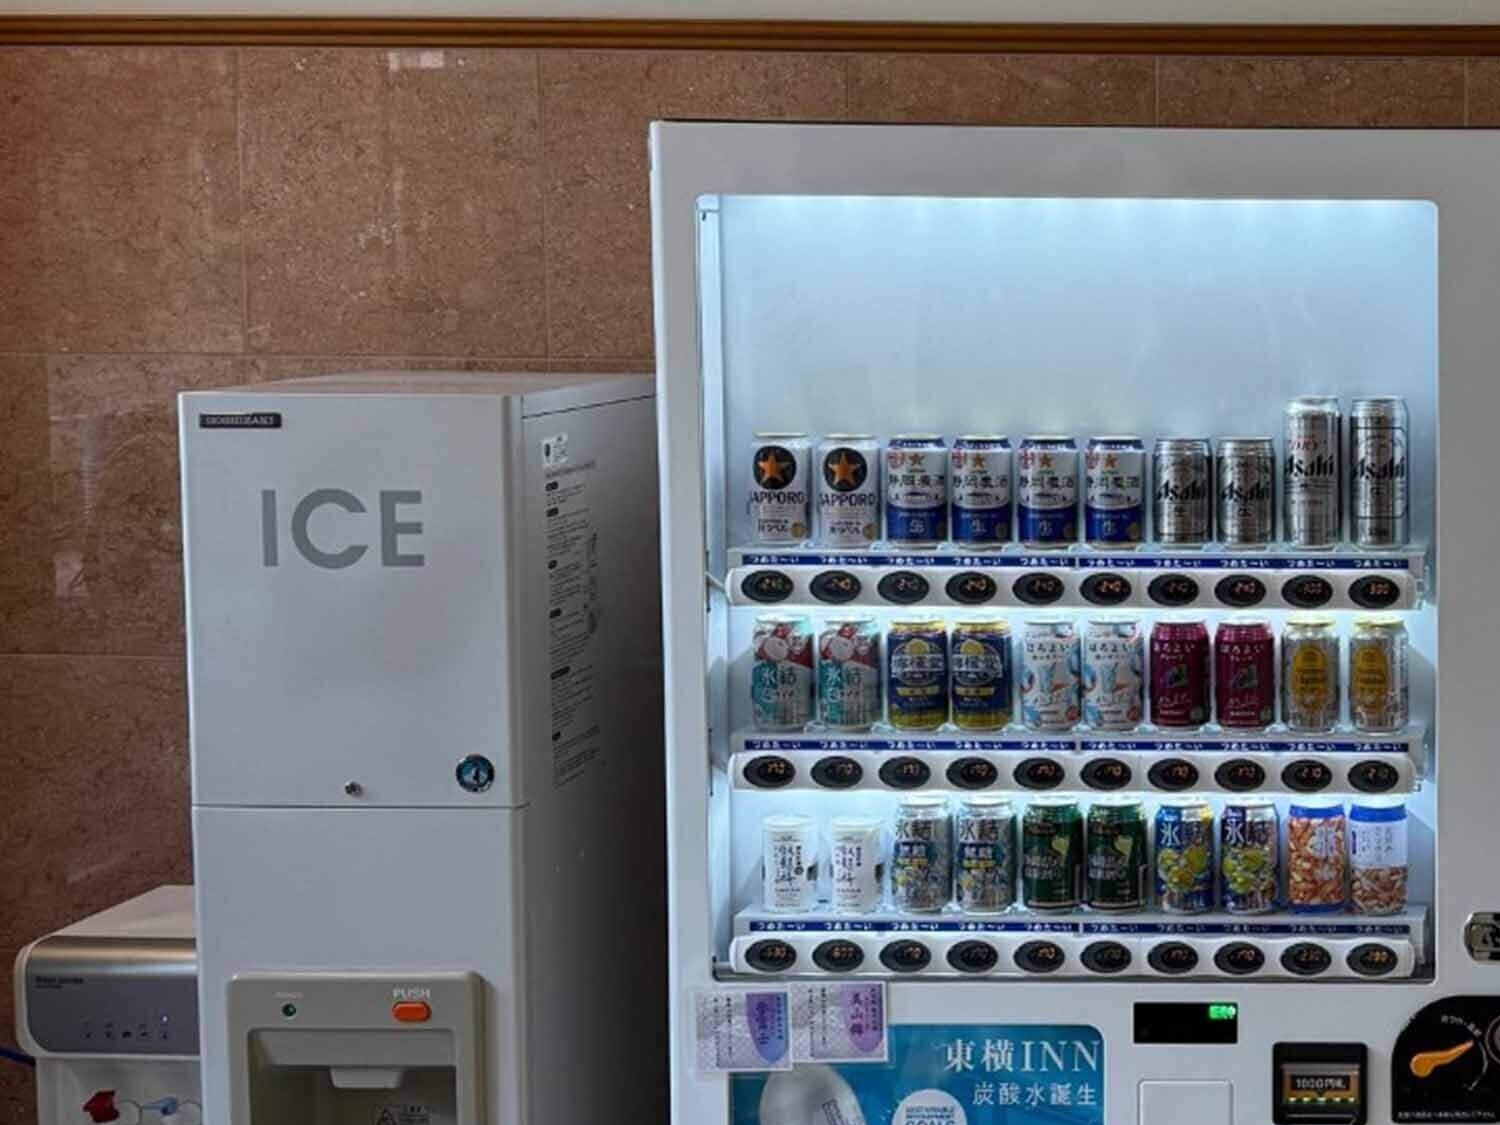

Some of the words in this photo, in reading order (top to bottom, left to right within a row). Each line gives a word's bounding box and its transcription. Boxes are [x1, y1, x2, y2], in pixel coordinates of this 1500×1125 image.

[262, 488, 425, 569] ICE
[392, 988, 431, 1000] PUSH
[944, 1038, 1100, 1073] 東横INN
[972, 1082, 1098, 1106] 炭酸水誕生
